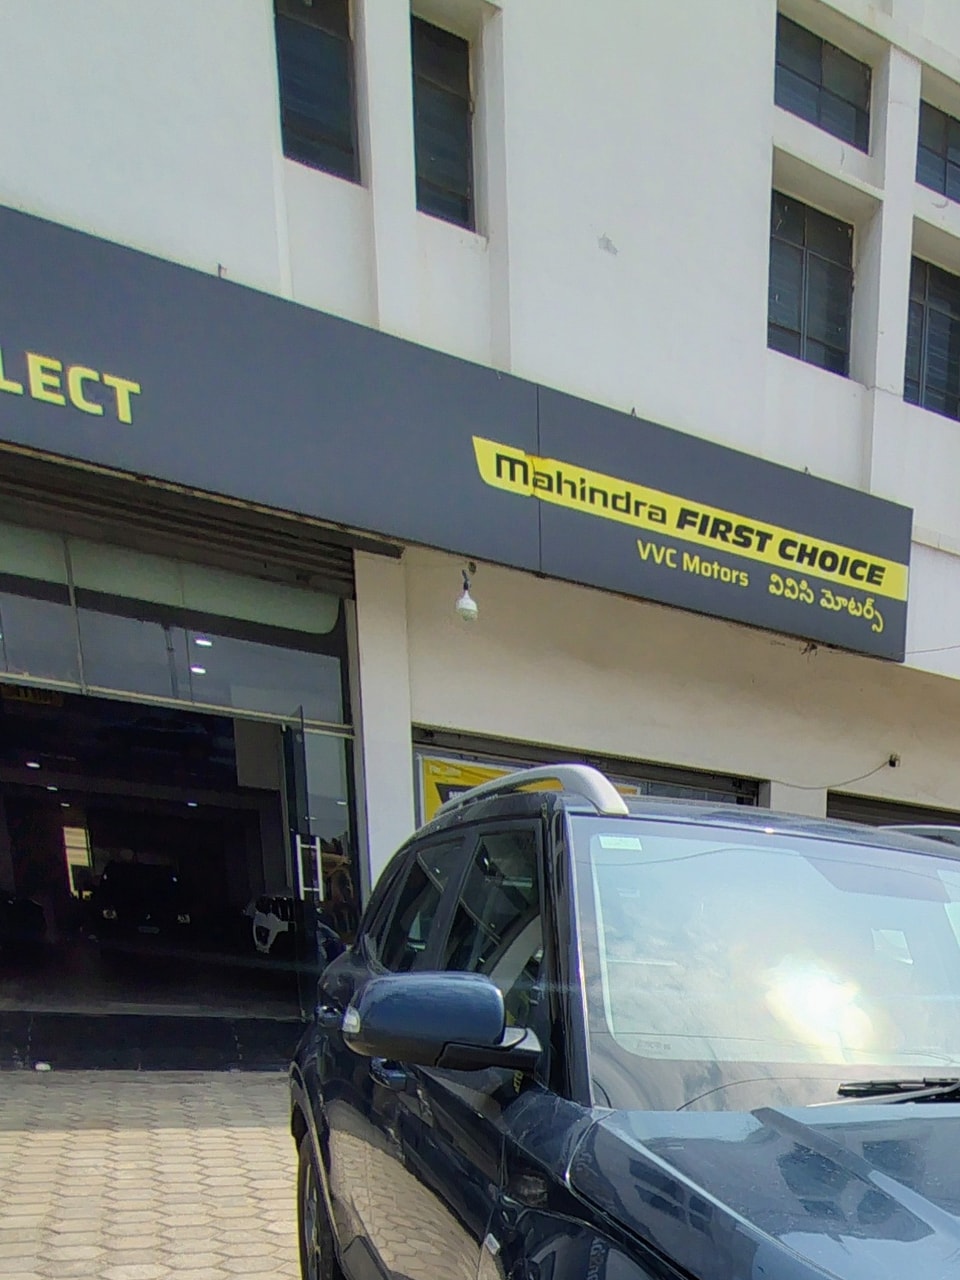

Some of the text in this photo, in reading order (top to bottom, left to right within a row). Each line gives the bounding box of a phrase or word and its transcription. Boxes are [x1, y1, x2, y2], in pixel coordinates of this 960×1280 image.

[637, 539, 749, 588] VVC Motors
[676, 507, 773, 553] FIRST
[778, 538, 886, 587] CHOICE
[768, 573, 815, 605] వివిసి
